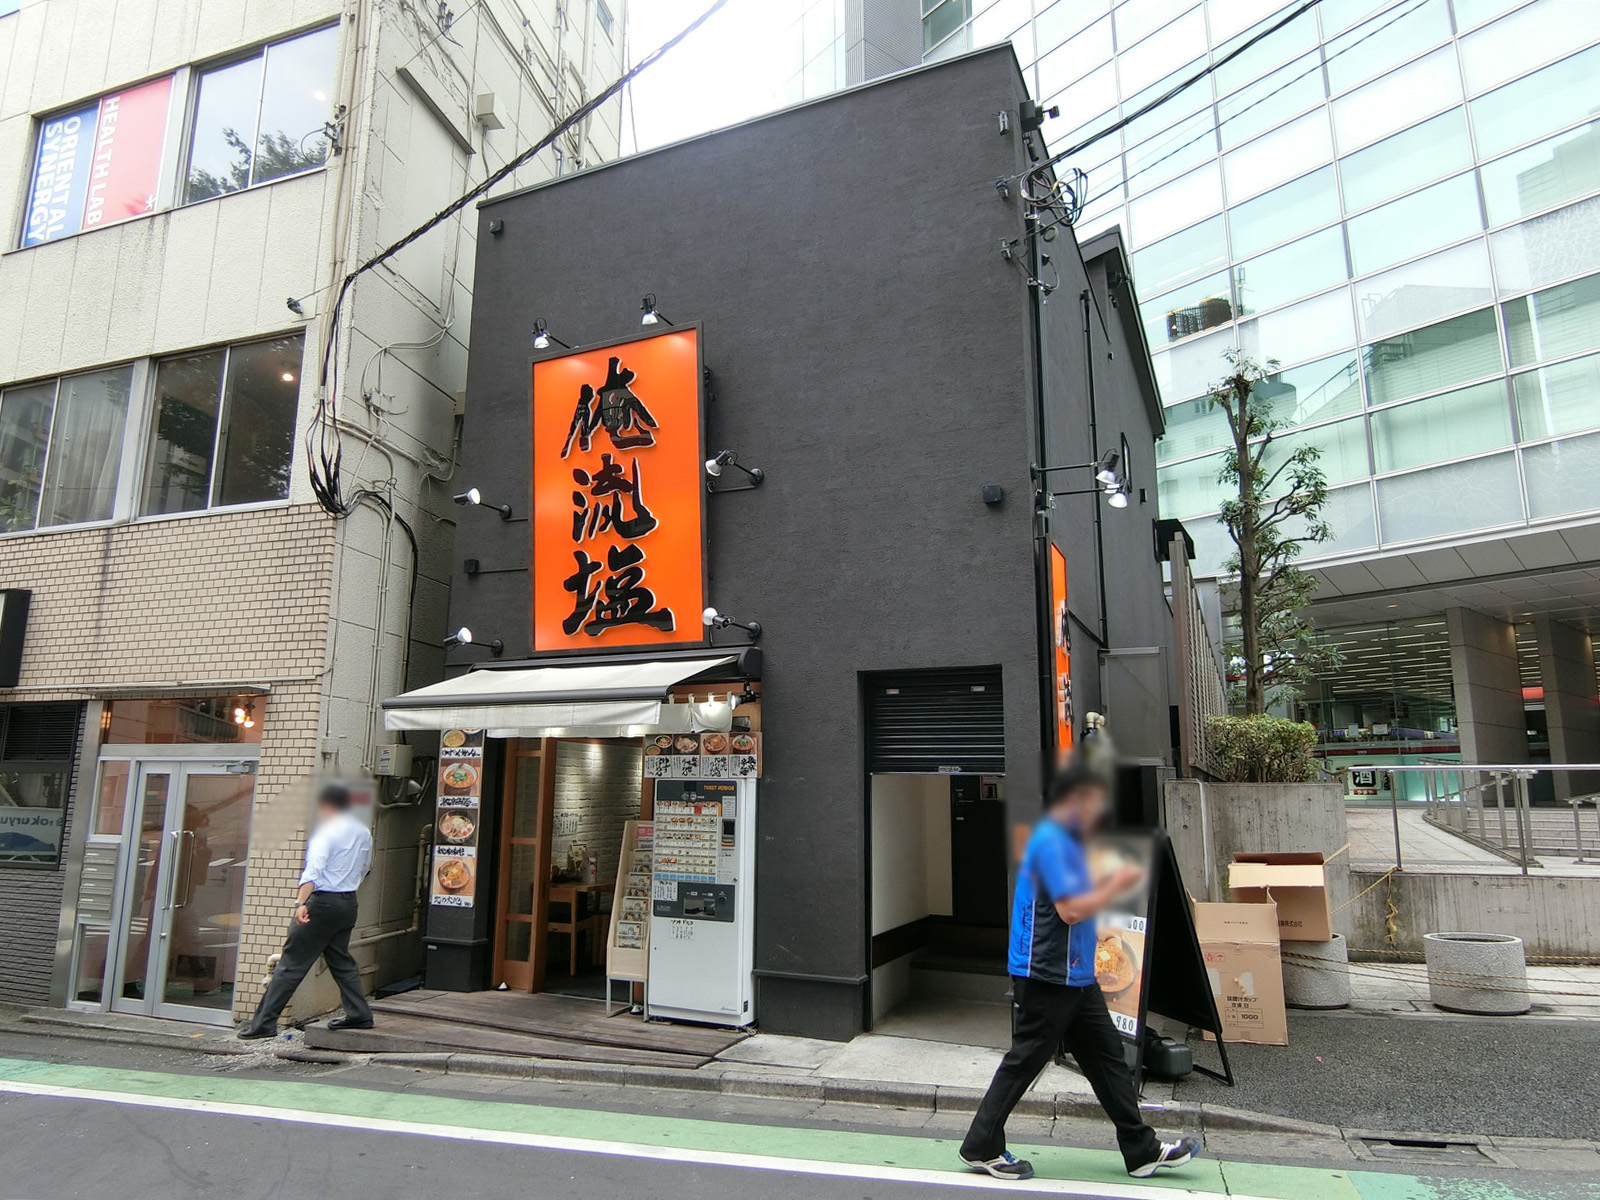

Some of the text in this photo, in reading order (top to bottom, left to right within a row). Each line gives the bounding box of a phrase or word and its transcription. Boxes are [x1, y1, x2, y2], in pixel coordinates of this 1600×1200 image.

[27, 122, 63, 241] SYNERGY
[46, 116, 82, 240] ORIENTAL
[87, 96, 121, 226] HEALTH LAB
[560, 356, 676, 637] 俺流塩
[1355, 770, 1373, 784] 酒
[1116, 1015, 1134, 1032] 980
[1240, 1013, 1259, 1021] 1000
